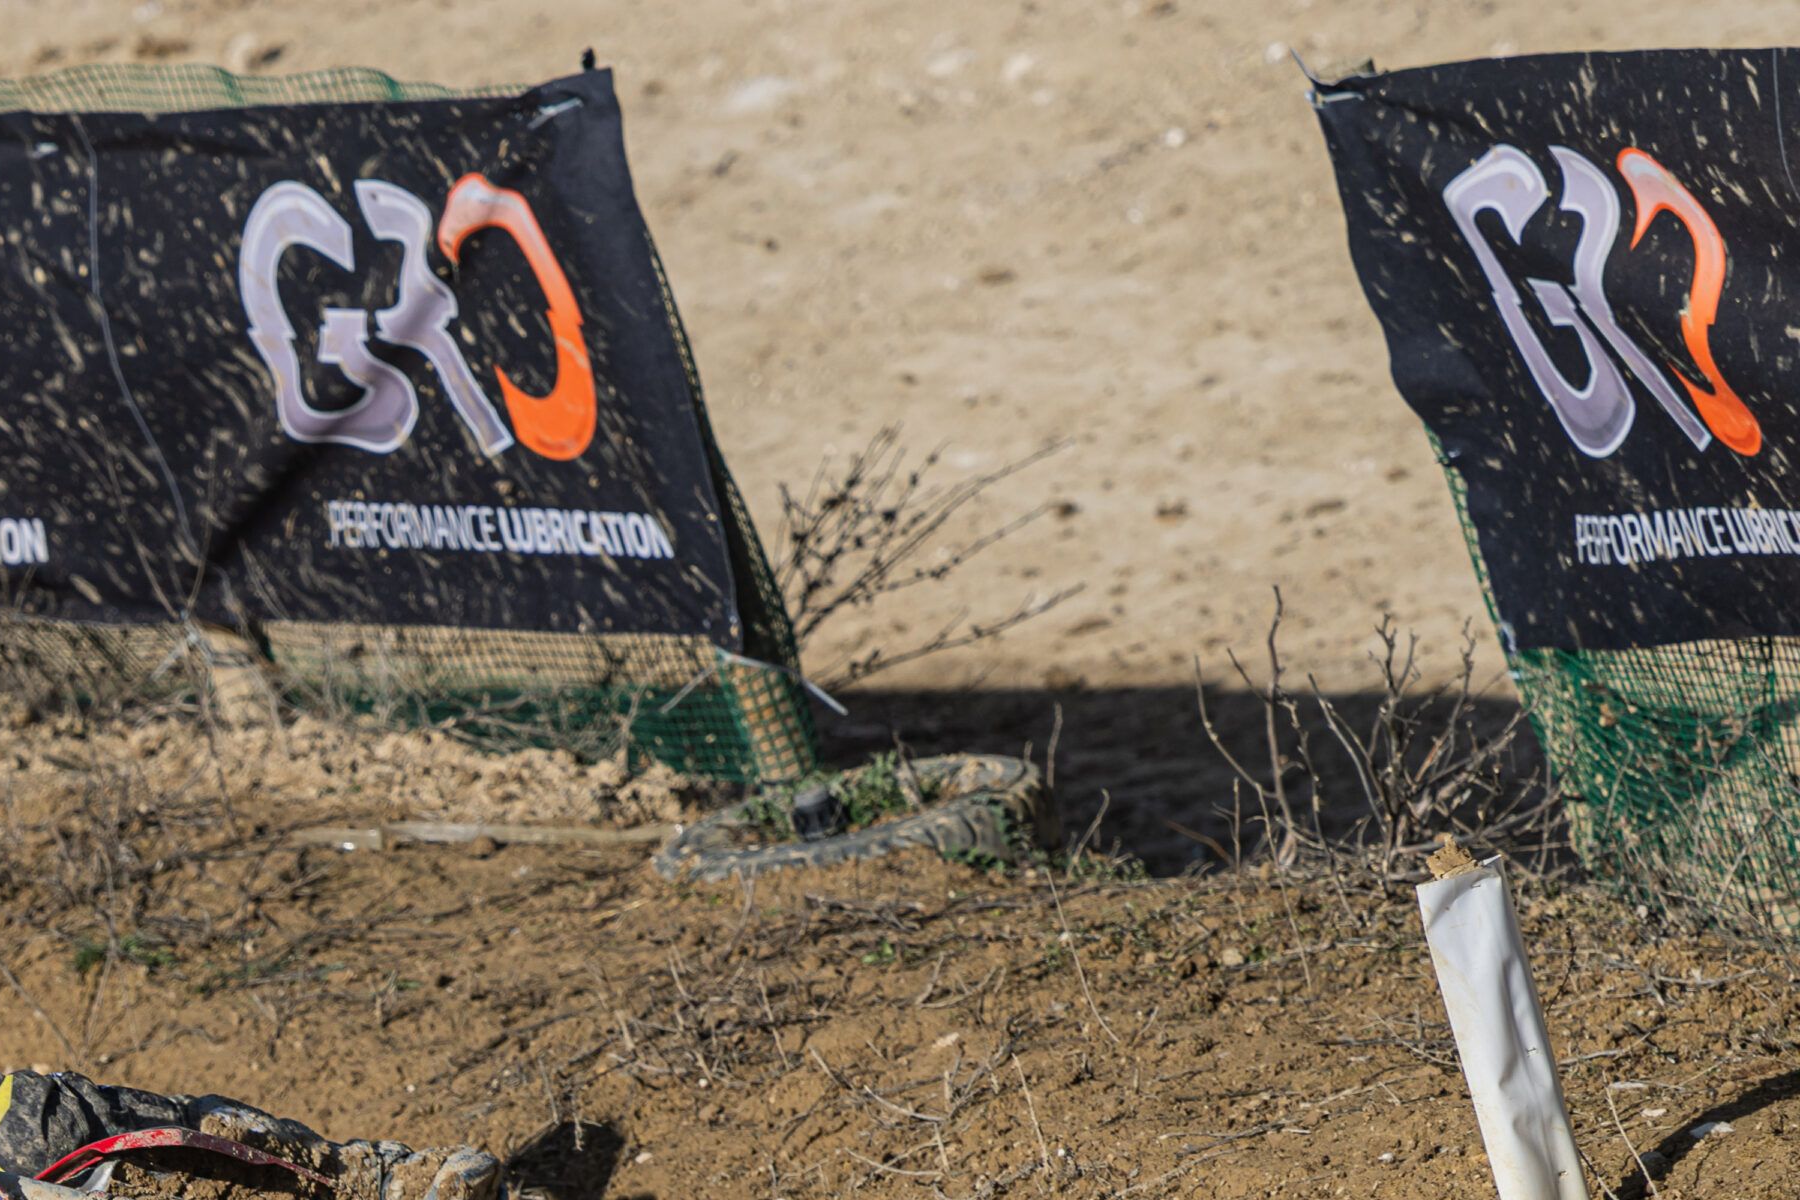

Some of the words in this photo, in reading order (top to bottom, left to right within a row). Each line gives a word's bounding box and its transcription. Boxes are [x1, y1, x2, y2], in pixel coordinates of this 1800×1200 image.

[328, 501, 501, 551] PERFORMANCE
[500, 508, 675, 558] LUBRICATION
[1574, 507, 1733, 565] PERFORMANCE
